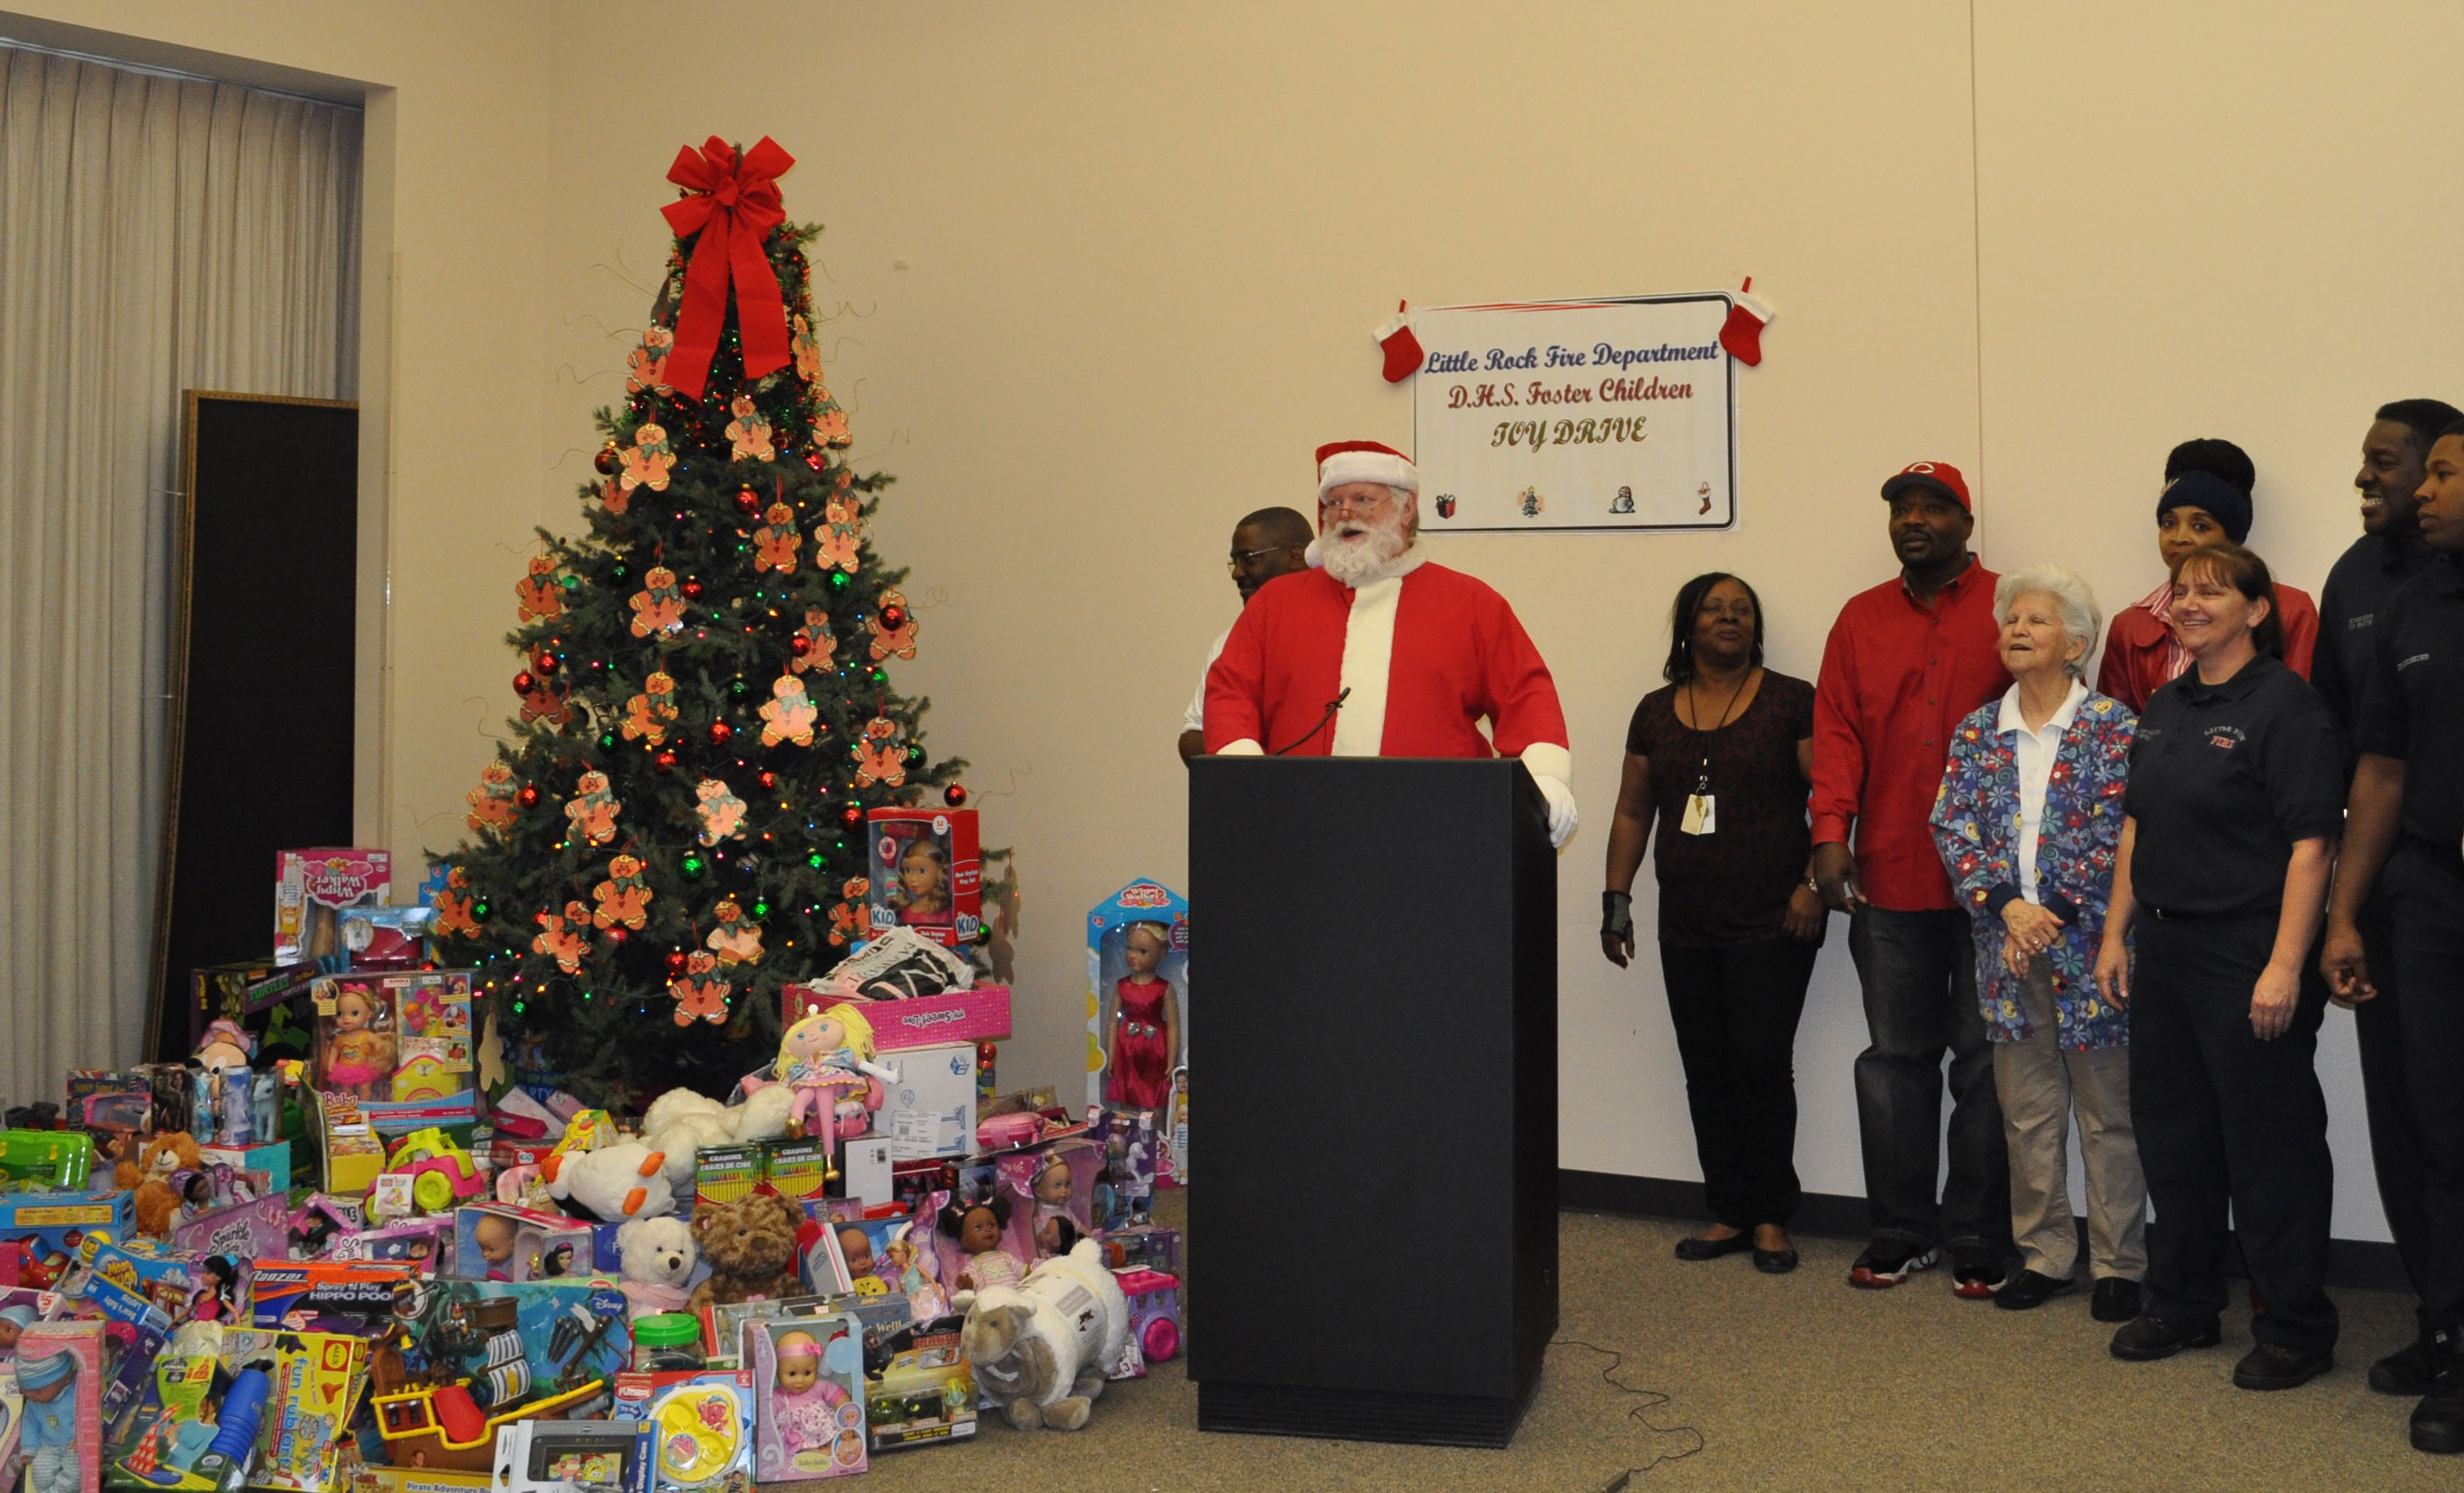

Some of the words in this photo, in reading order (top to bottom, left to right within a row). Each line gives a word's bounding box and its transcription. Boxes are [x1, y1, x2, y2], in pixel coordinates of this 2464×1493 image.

[1425, 351, 1478, 373] Little
[1484, 346, 1537, 371] Rock
[1544, 346, 1586, 368] Fire
[1592, 341, 1719, 371] Department
[1447, 384, 1519, 409] D.H.S.
[1526, 381, 1593, 406] Foster
[1599, 376, 1693, 403] Children
[1491, 421, 1547, 453] TOY
[1552, 416, 1648, 444] DRIVE
[871, 908, 895, 924] KID
[957, 916, 979, 934] KID
[309, 1292, 356, 1300] HIPPO
[316, 1282, 346, 1291] Spray
[360, 1283, 383, 1292] Play
[592, 1298, 624, 1312] Disney
[289, 1356, 308, 1390] fun
[285, 1395, 300, 1430] rub
[280, 1435, 294, 1465] art
[640, 1441, 649, 1460] Case
[406, 1482, 432, 1491] Pirate
[637, 1461, 649, 1490] Display
